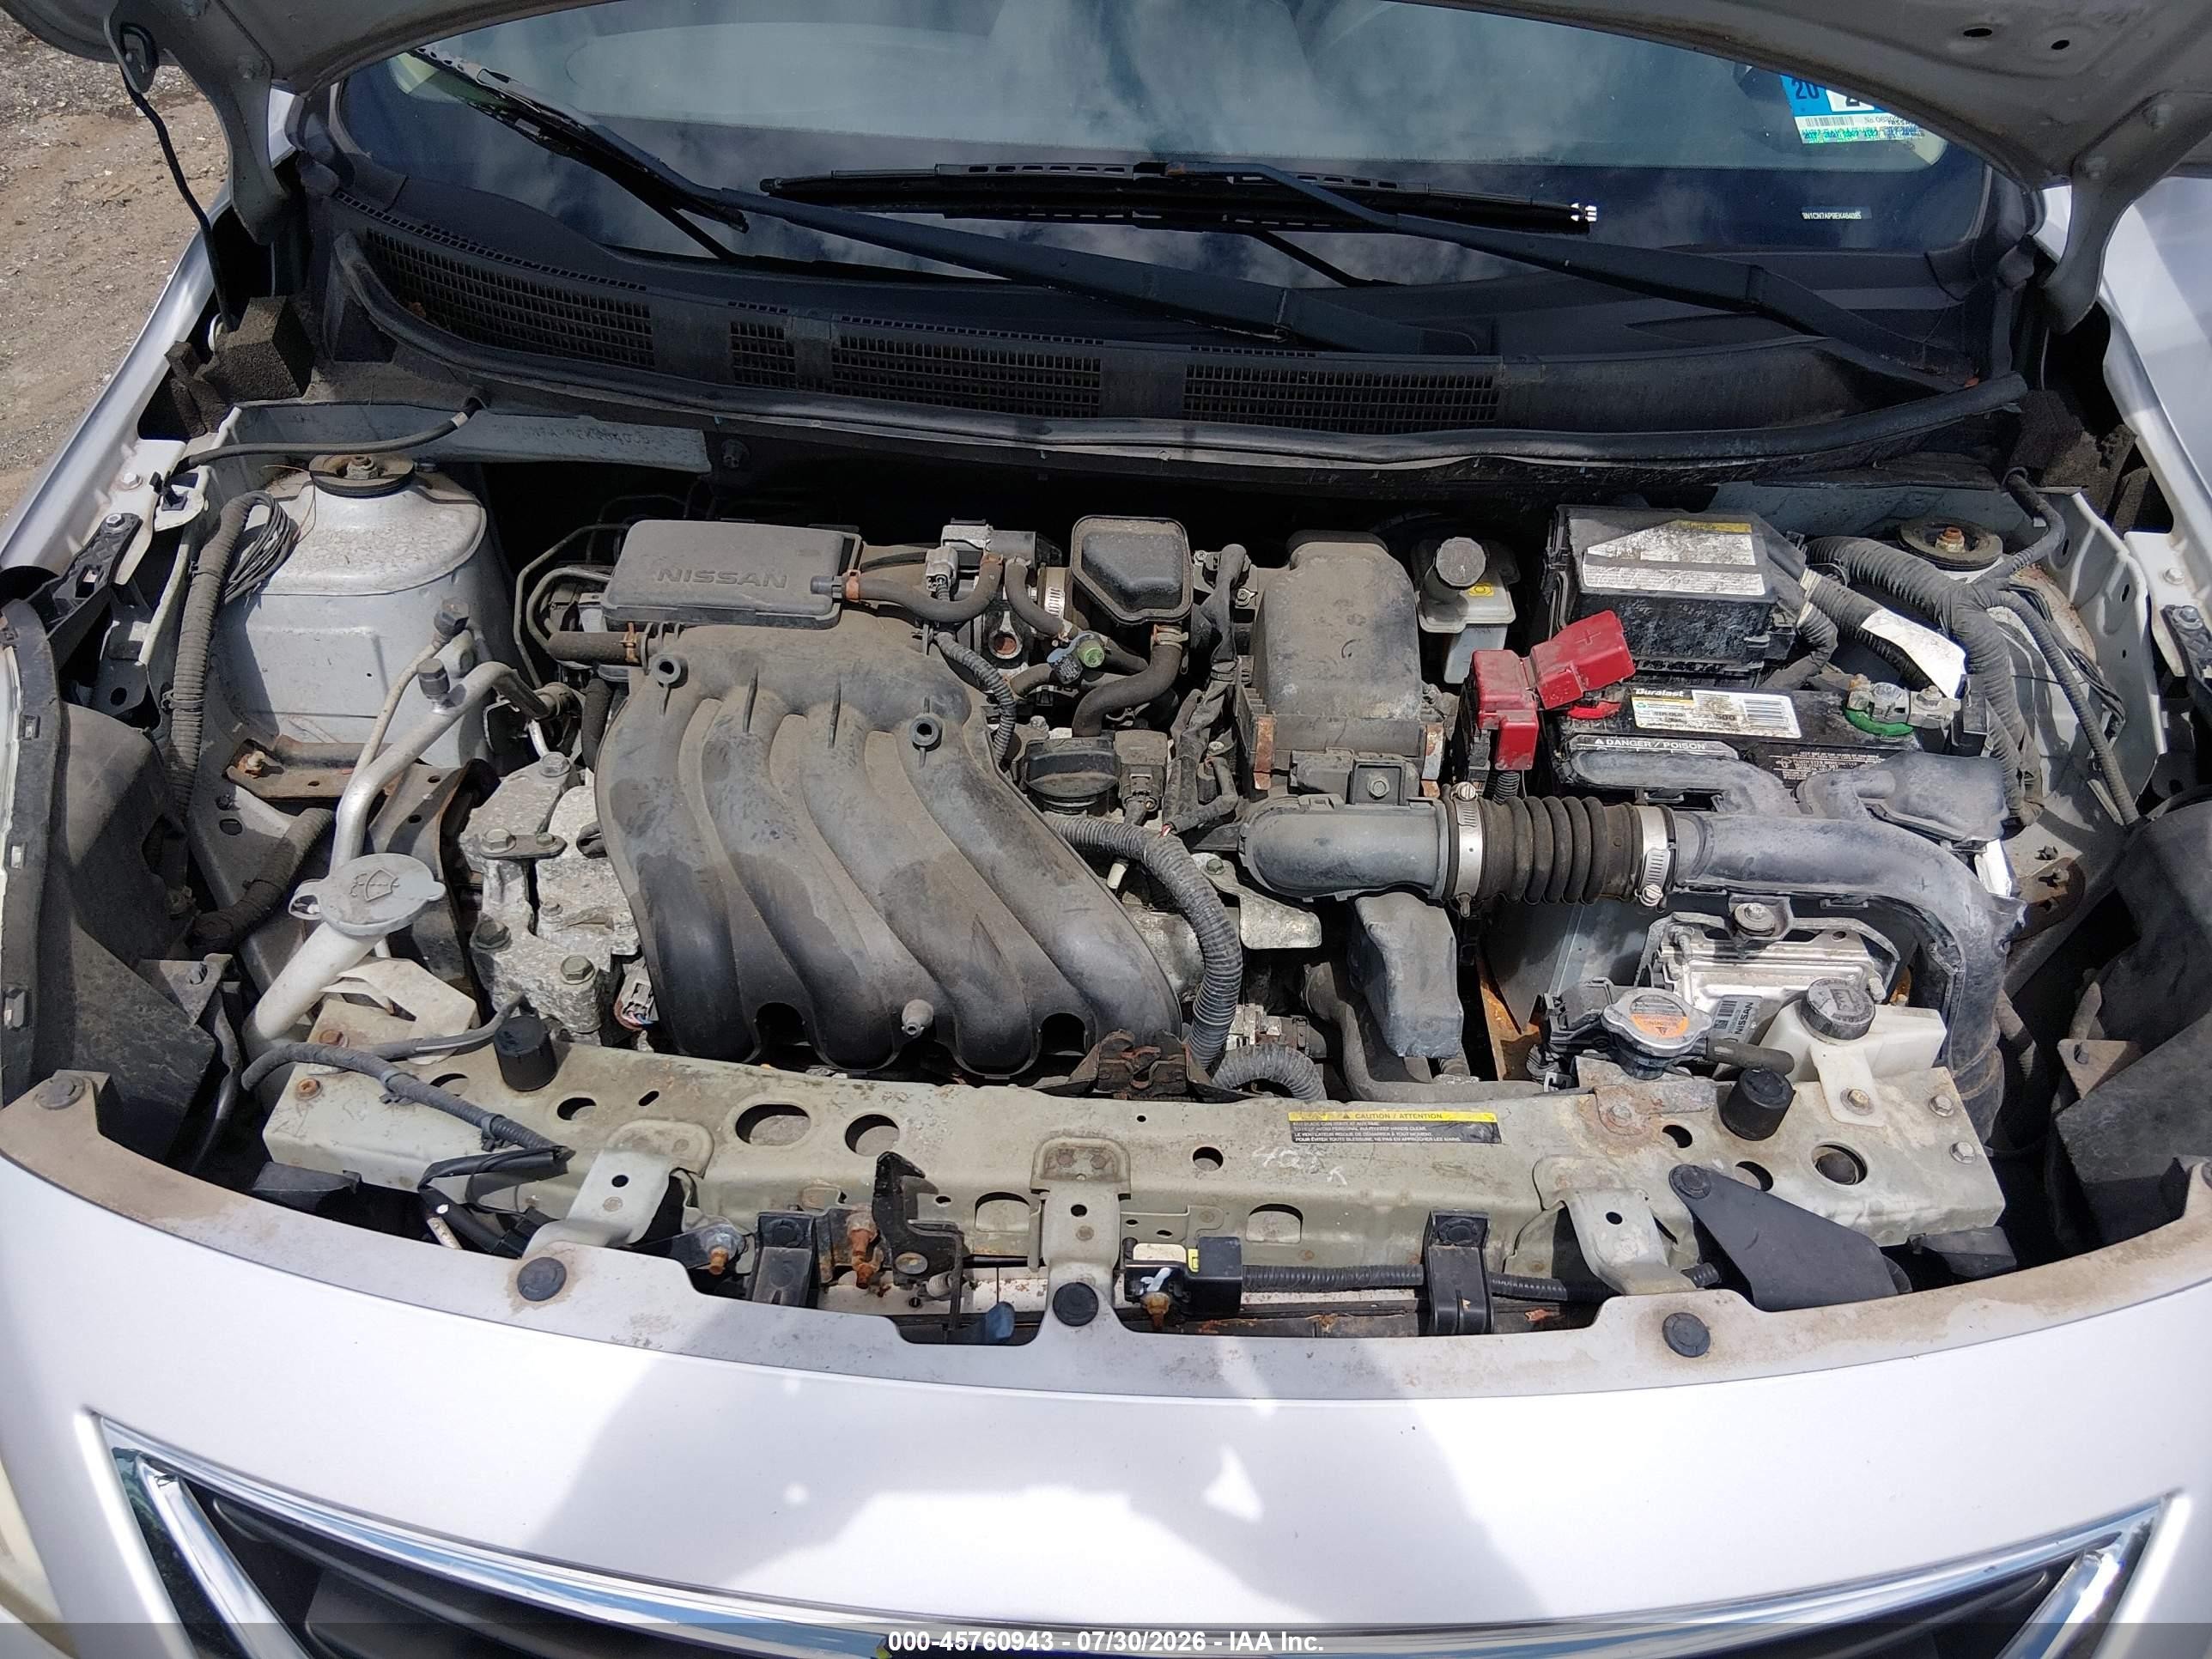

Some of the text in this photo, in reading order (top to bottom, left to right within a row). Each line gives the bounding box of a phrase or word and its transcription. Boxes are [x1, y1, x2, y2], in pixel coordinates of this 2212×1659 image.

[657, 568, 787, 588] NISSAN
[1633, 688, 1684, 696] Duralast
[1734, 1002, 1753, 1035] NISSAN
